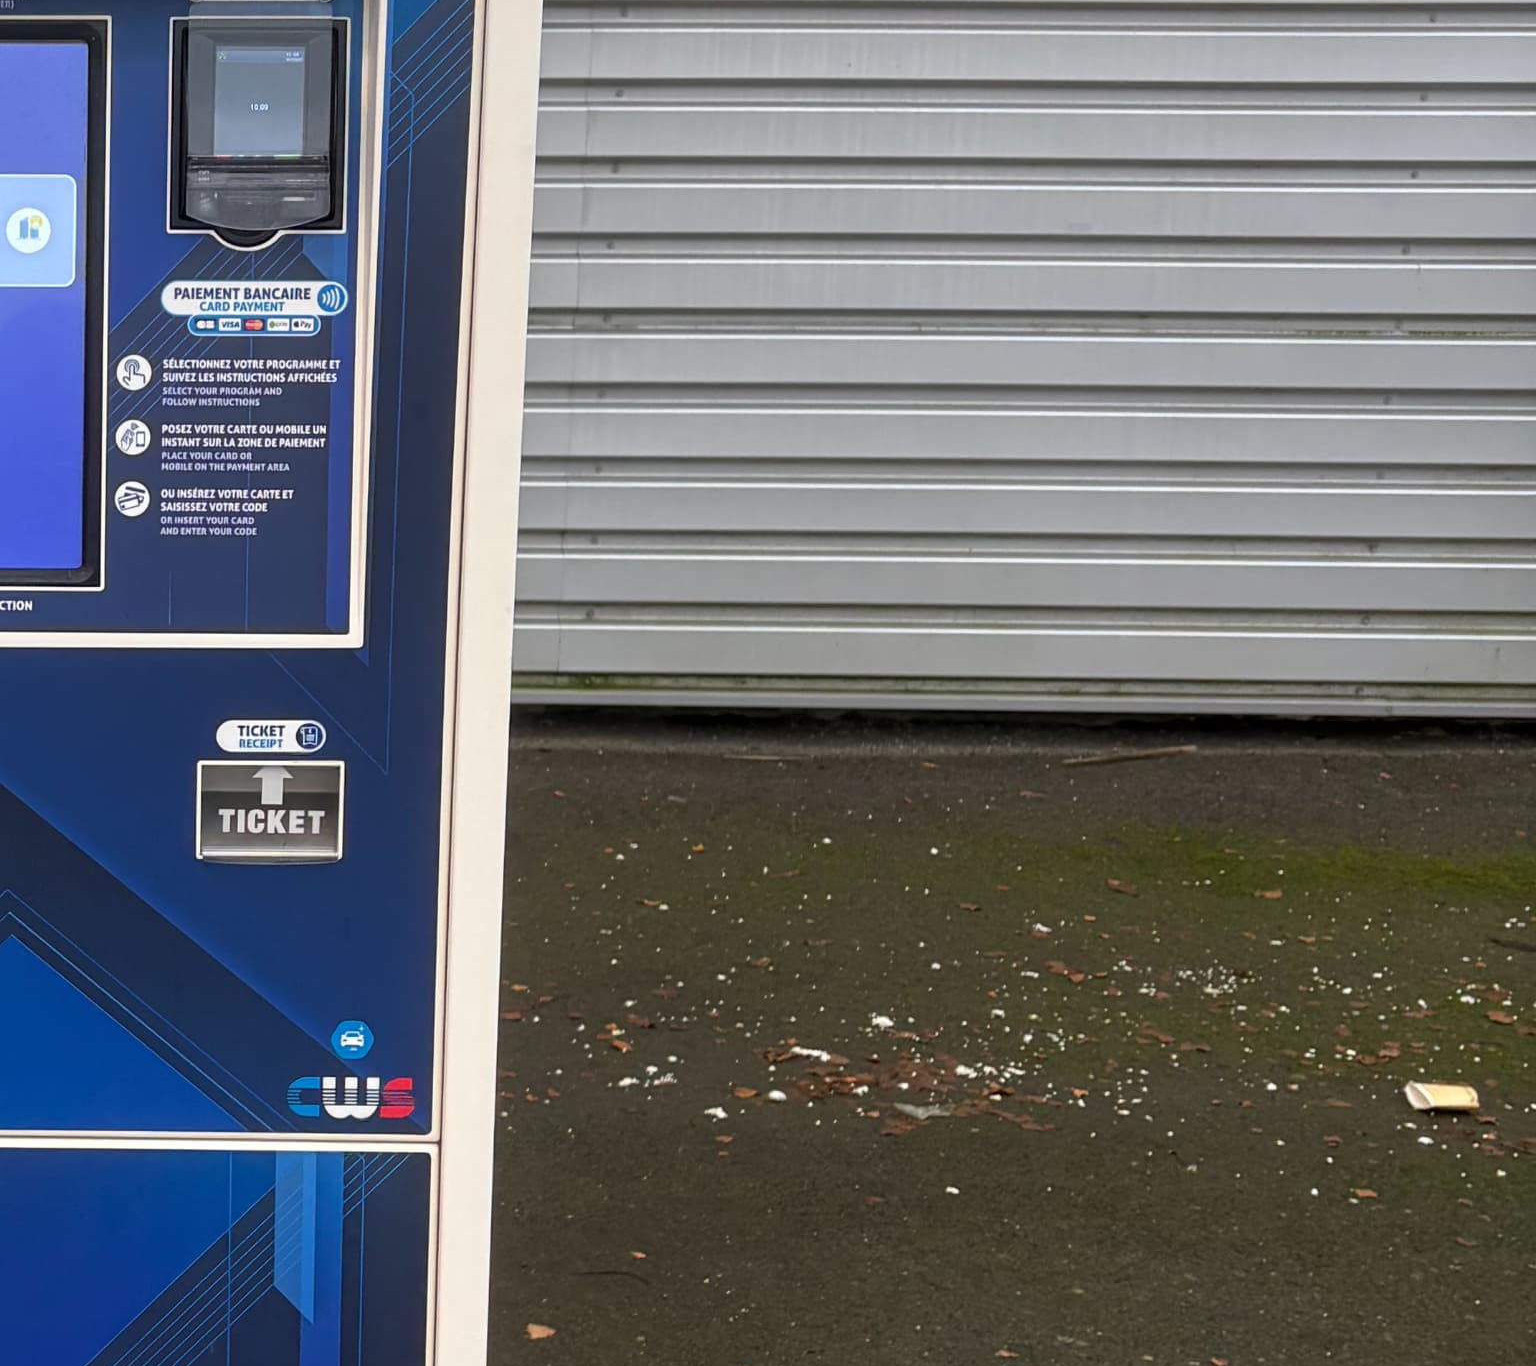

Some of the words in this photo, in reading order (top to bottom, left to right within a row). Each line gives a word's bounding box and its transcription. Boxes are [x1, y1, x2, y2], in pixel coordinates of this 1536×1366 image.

[174, 287, 240, 300] PAIEMENT
[244, 287, 311, 300] BANCAIRE
[199, 301, 230, 311] CARD
[233, 301, 285, 311] PAYMENT
[222, 321, 240, 329] VISA
[300, 321, 312, 329] Pay
[162, 359, 230, 370] SÉLECTIONNEZ
[234, 360, 264, 370] VOTRE
[266, 360, 328, 370] PROGRAMME
[330, 360, 341, 370] ET
[162, 373, 197, 383] SUIVEZ
[199, 373, 214, 383] LES
[217, 373, 286, 383] INSTRUCTIONS
[288, 371, 338, 383] AFFICHÉES
[162, 387, 192, 396] SELECT
[194, 387, 218, 396] YOUR
[220, 387, 262, 396] PROGRAM
[264, 387, 282, 396] AND
[162, 398, 197, 407] FOLLOW
[199, 398, 260, 407] INSTRUCTIONS
[162, 424, 192, 434] POSEZ
[194, 424, 225, 434] VOTRE
[227, 424, 257, 434] CARTE
[259, 424, 274, 434] OU
[276, 424, 311, 434] MOBILE
[313, 424, 327, 434] UN
[162, 437, 200, 447] INSTANT
[202, 437, 222, 447] SUR
[224, 437, 236, 447] LA
[238, 437, 262, 447] ZONE
[264, 437, 278, 447] DE
[279, 437, 326, 447] PAIEMENT
[162, 451, 188, 461] PLACE
[189, 451, 213, 461] YOUR
[214, 451, 238, 461] CARD
[240, 451, 252, 461] OR
[162, 463, 192, 471] MOBILE
[194, 463, 208, 471] ON
[208, 463, 225, 471] THE
[227, 463, 266, 471] PAYMENT
[268, 463, 290, 471] AREA
[160, 489, 176, 499] OU
[177, 487, 216, 499] INSÉREZ
[217, 489, 249, 499] VOTRE
[250, 489, 280, 499] CARTE
[282, 489, 294, 499] ET
[160, 502, 208, 513] SAISISSEZ
[209, 502, 240, 513] VOTRE
[242, 502, 268, 513] CODE
[160, 516, 173, 525] OR
[174, 516, 204, 525] INSERT
[206, 516, 229, 525] YOUR
[231, 516, 254, 525] CARD
[160, 527, 179, 535] AND
[180, 527, 207, 535] ENTER
[209, 527, 232, 535] YOUR
[234, 527, 257, 535] CODE
[238, 725, 286, 737] TICKET
[239, 739, 284, 749] RECEIPT
[218, 809, 326, 835] TICKET
[287, 1076, 415, 1119] CWS
